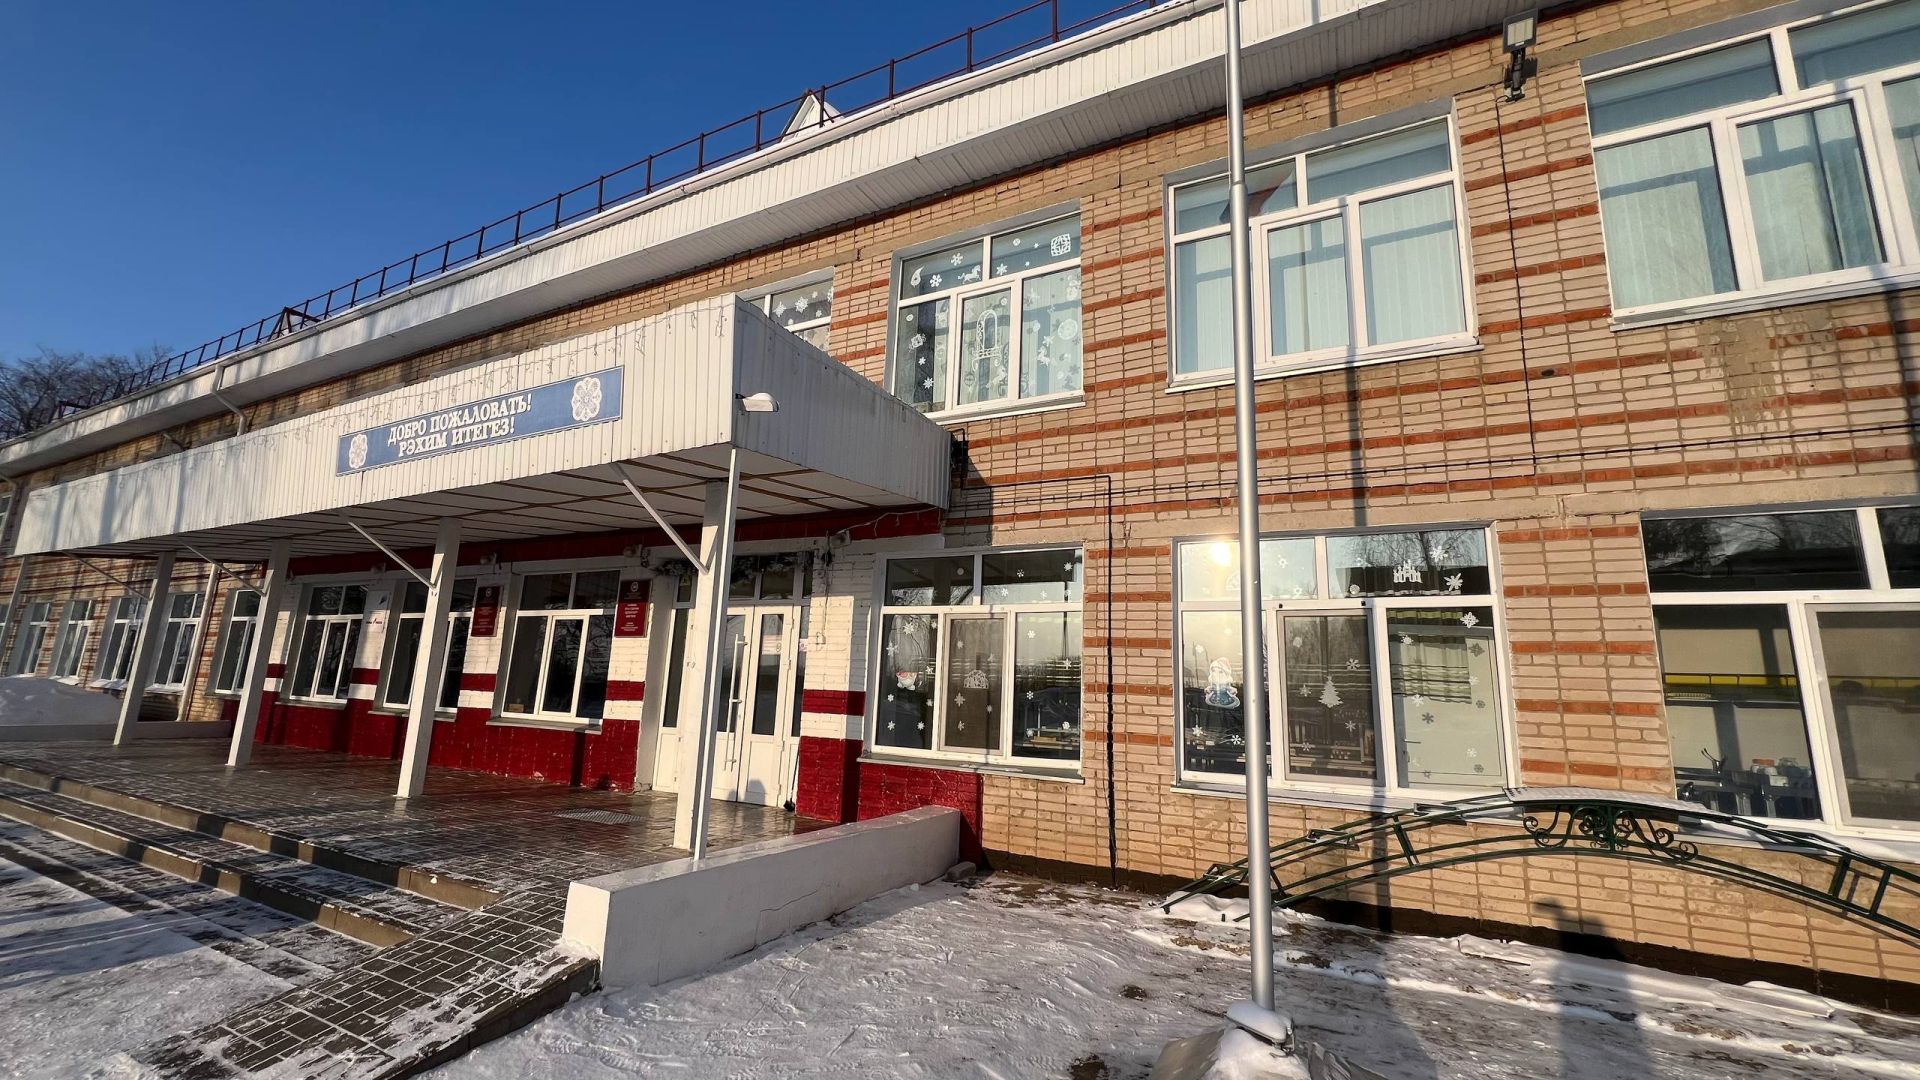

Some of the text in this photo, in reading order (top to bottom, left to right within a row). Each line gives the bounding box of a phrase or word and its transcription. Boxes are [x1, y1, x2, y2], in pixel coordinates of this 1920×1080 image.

[388, 393, 532, 447] ДОБРО ПОЖАЛОВАТЬ!
[398, 416, 515, 457] РӘХИМ ИТЕГЕЗ!
